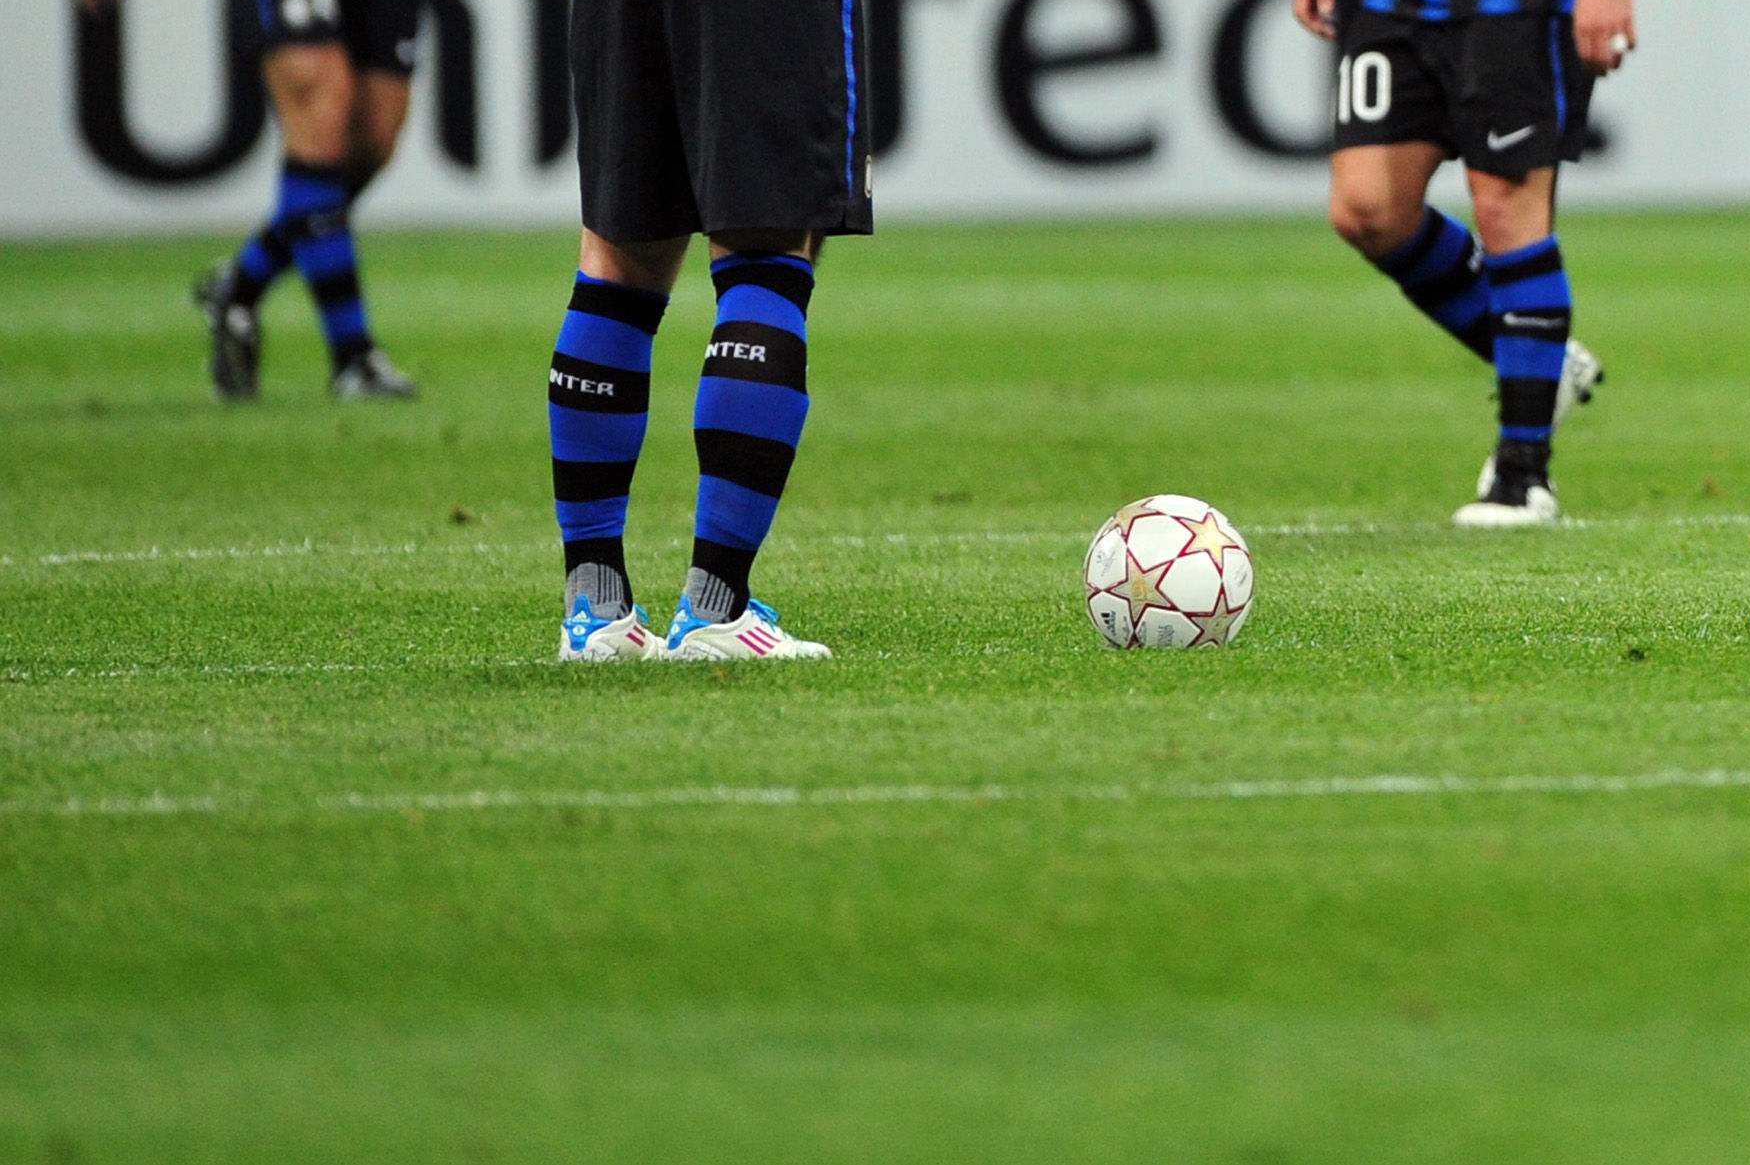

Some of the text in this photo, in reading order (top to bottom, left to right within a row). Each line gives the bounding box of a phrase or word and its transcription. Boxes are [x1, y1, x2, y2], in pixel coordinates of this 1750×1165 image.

[1338, 51, 1392, 124] 10
[704, 341, 766, 362] NTER
[549, 368, 614, 396] NTER
